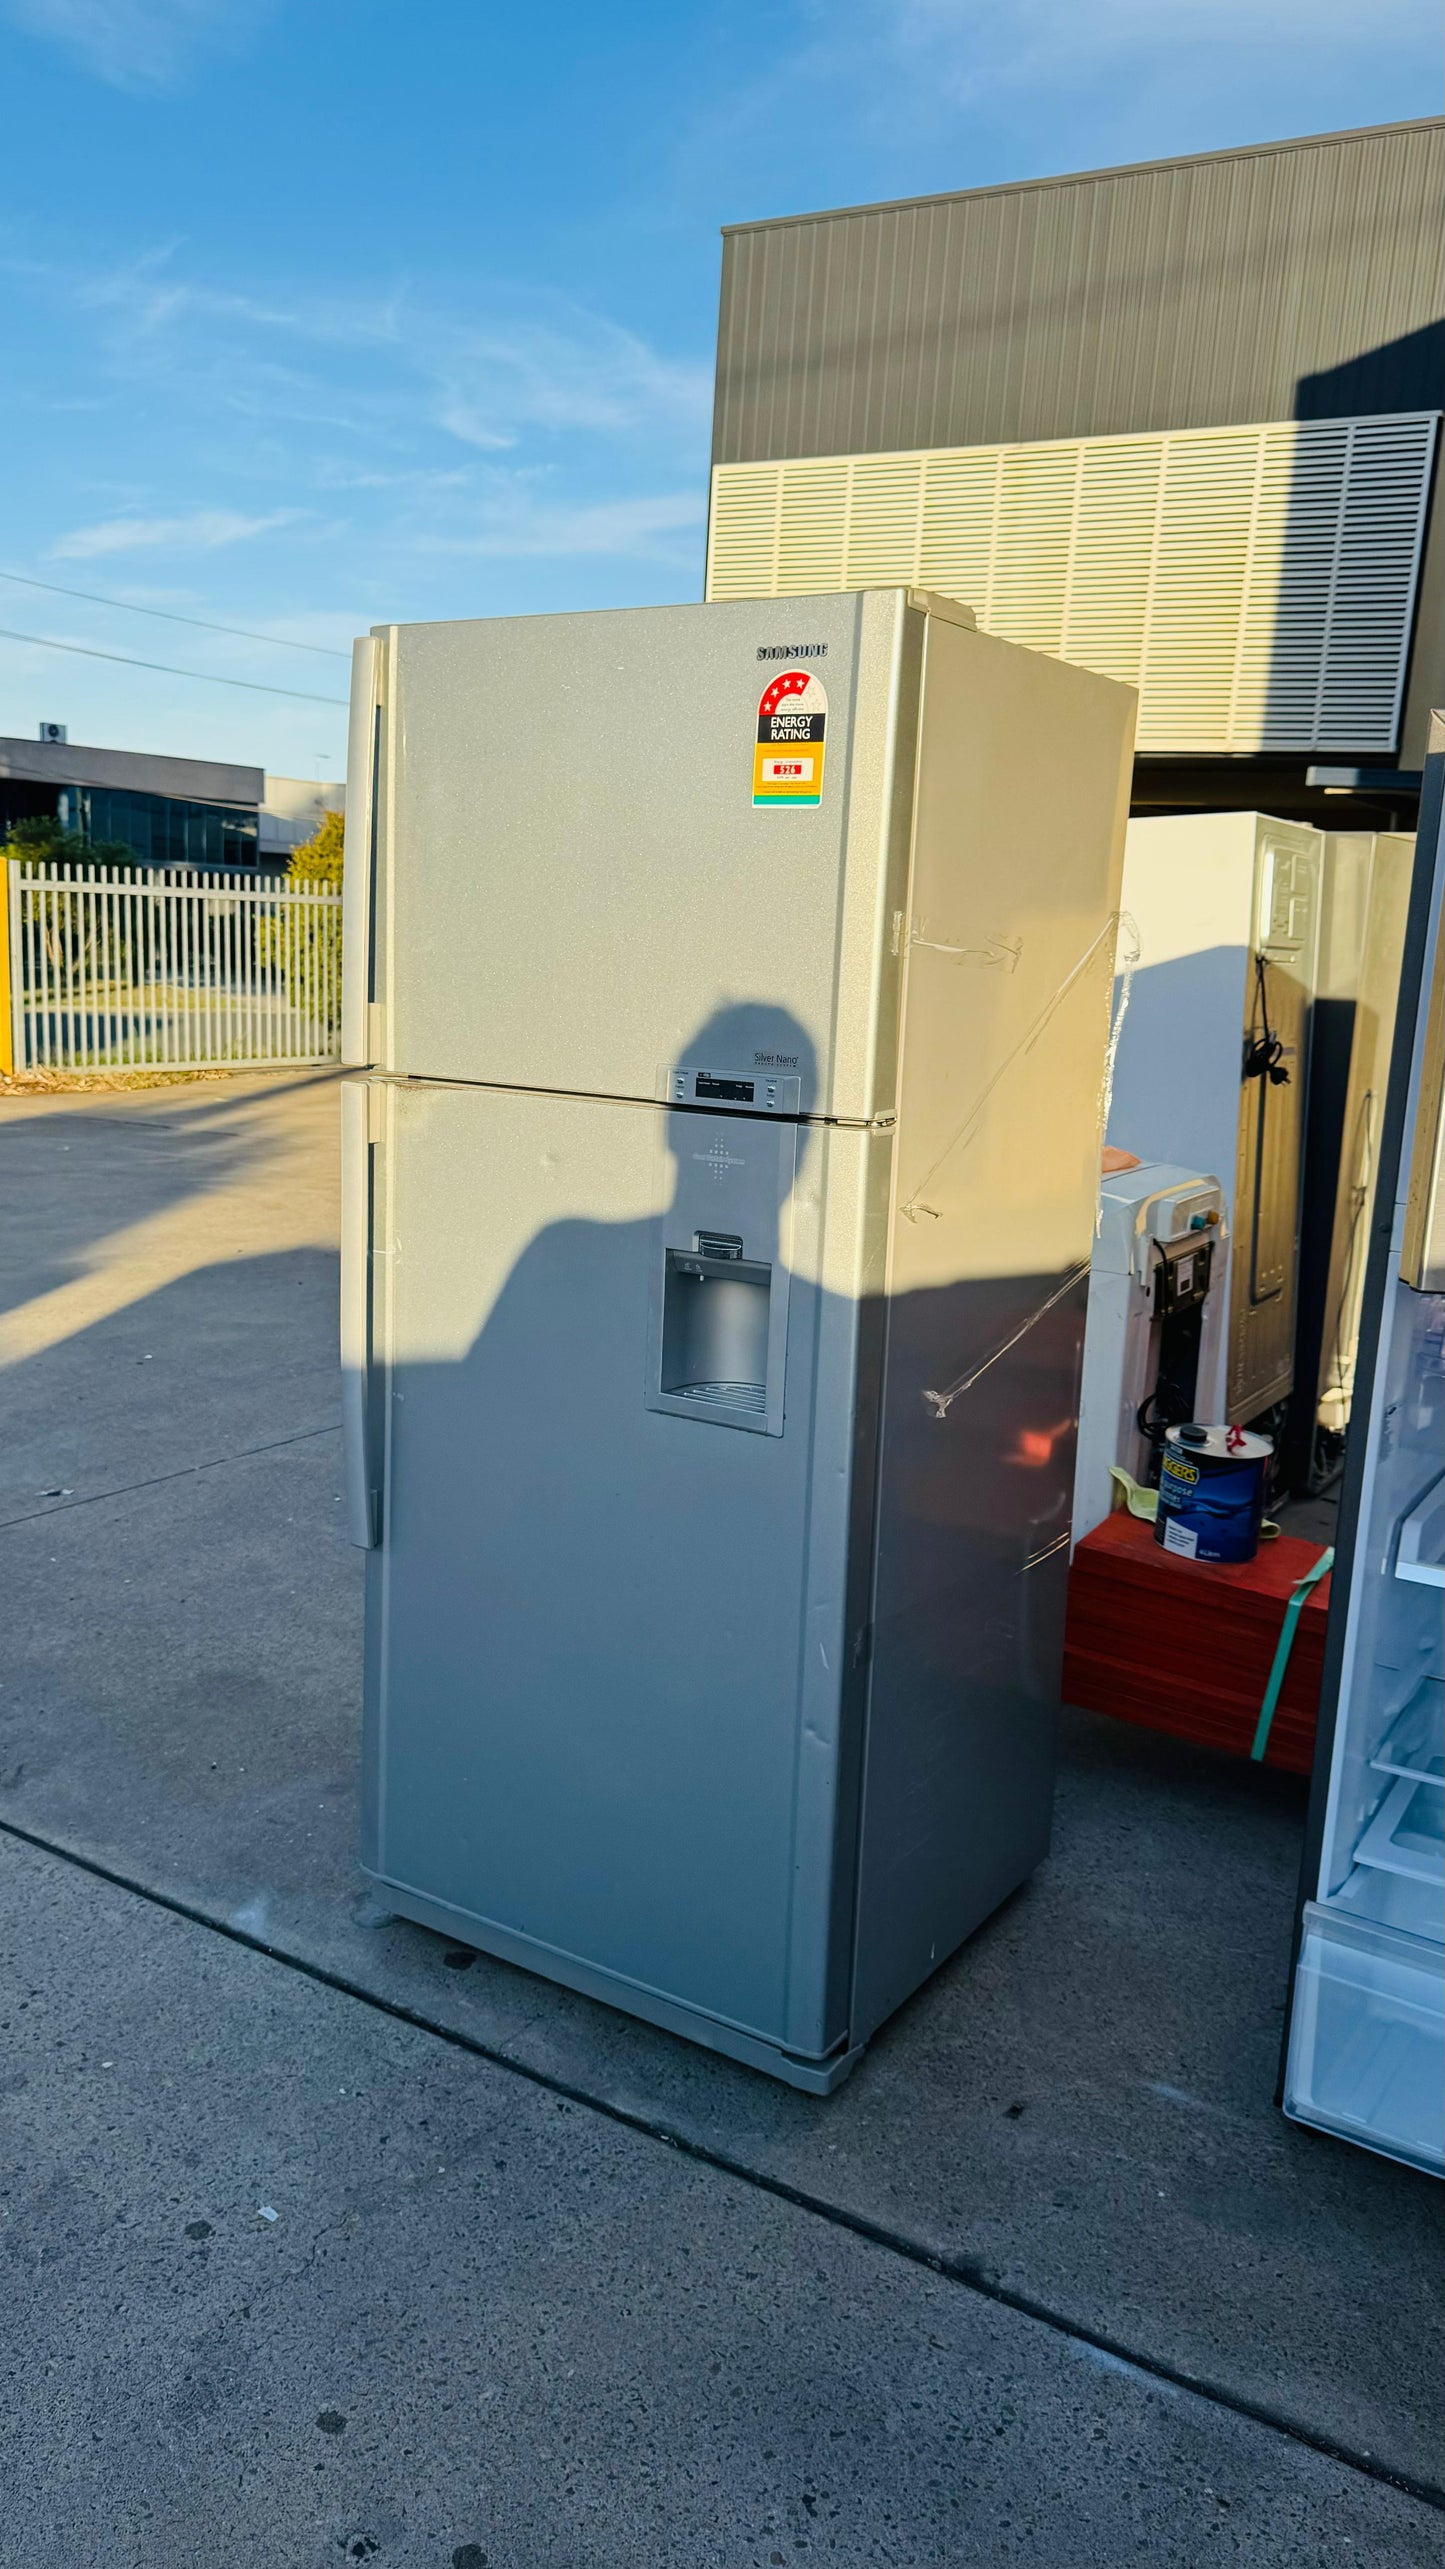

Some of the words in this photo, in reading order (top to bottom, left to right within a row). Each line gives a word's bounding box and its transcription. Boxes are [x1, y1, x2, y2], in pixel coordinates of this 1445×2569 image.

[756, 643, 828, 661] SAMSUNG
[770, 715, 813, 728] ENERGY
[770, 728, 811, 741] RATING
[779, 765, 796, 774] 526
[754, 1052, 774, 1062] Silver
[776, 1054, 798, 1064] Nano
[1162, 1456, 1196, 1481] GGERS
